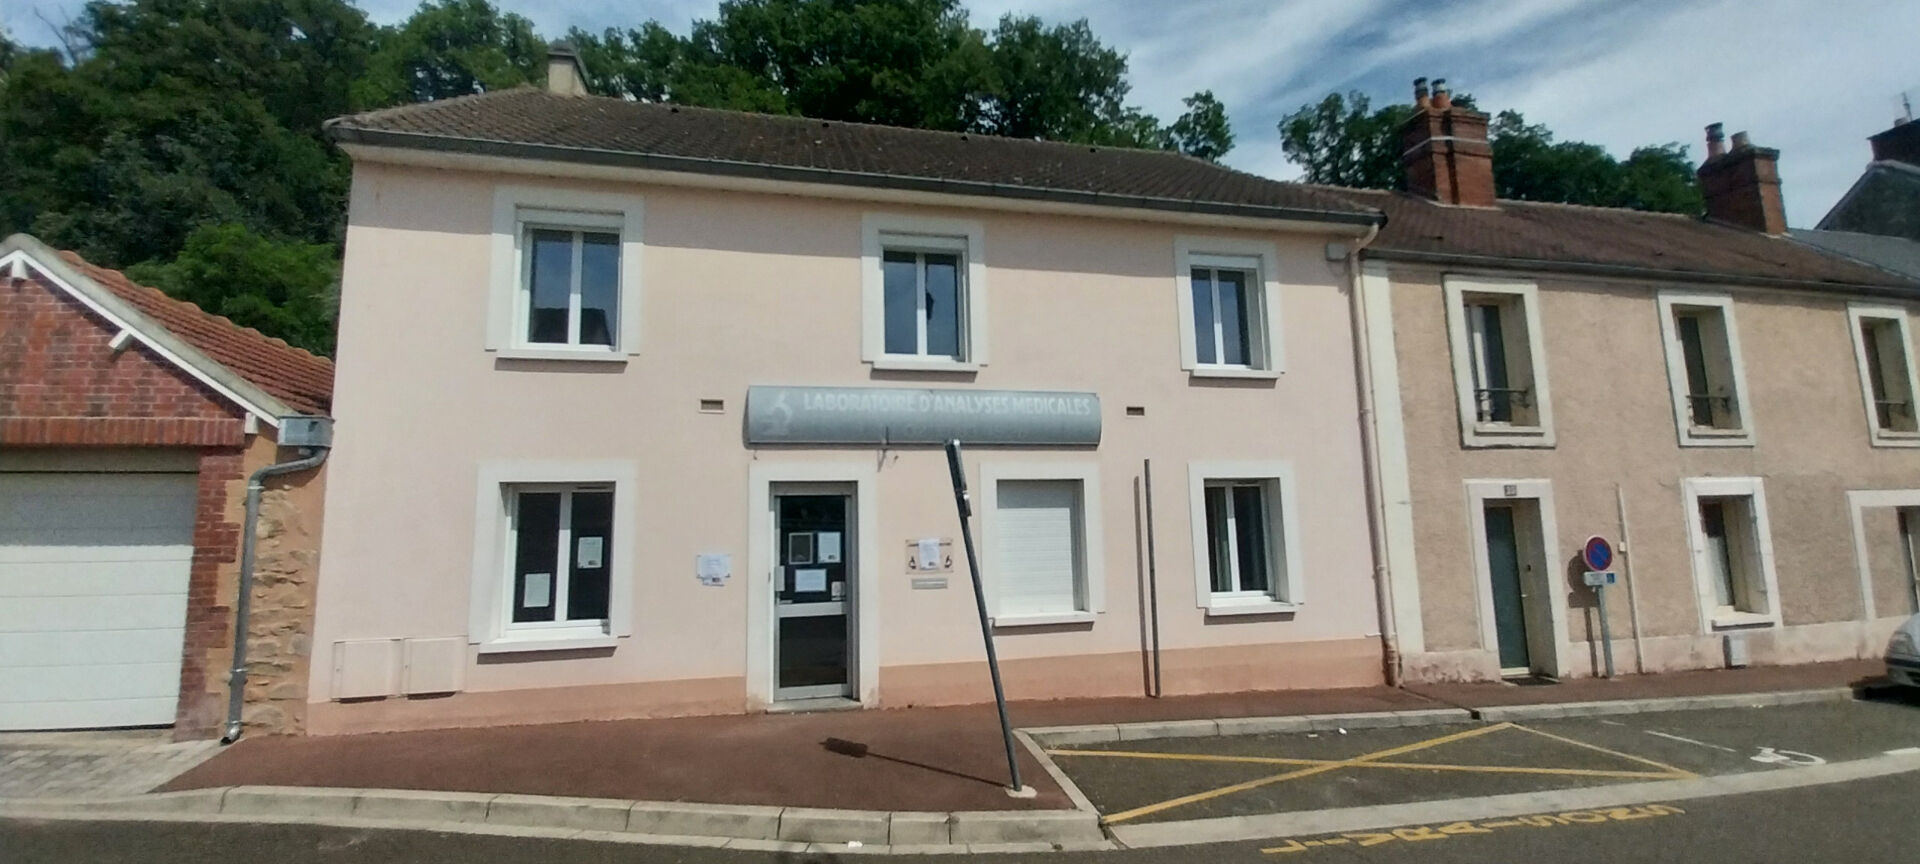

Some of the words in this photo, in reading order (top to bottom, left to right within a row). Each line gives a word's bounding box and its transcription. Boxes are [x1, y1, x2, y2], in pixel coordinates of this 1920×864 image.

[803, 392, 917, 412] LABORATOIRE
[919, 394, 1009, 415] D'ANALYSES
[1260, 804, 1686, 854] LIVRAISONS
